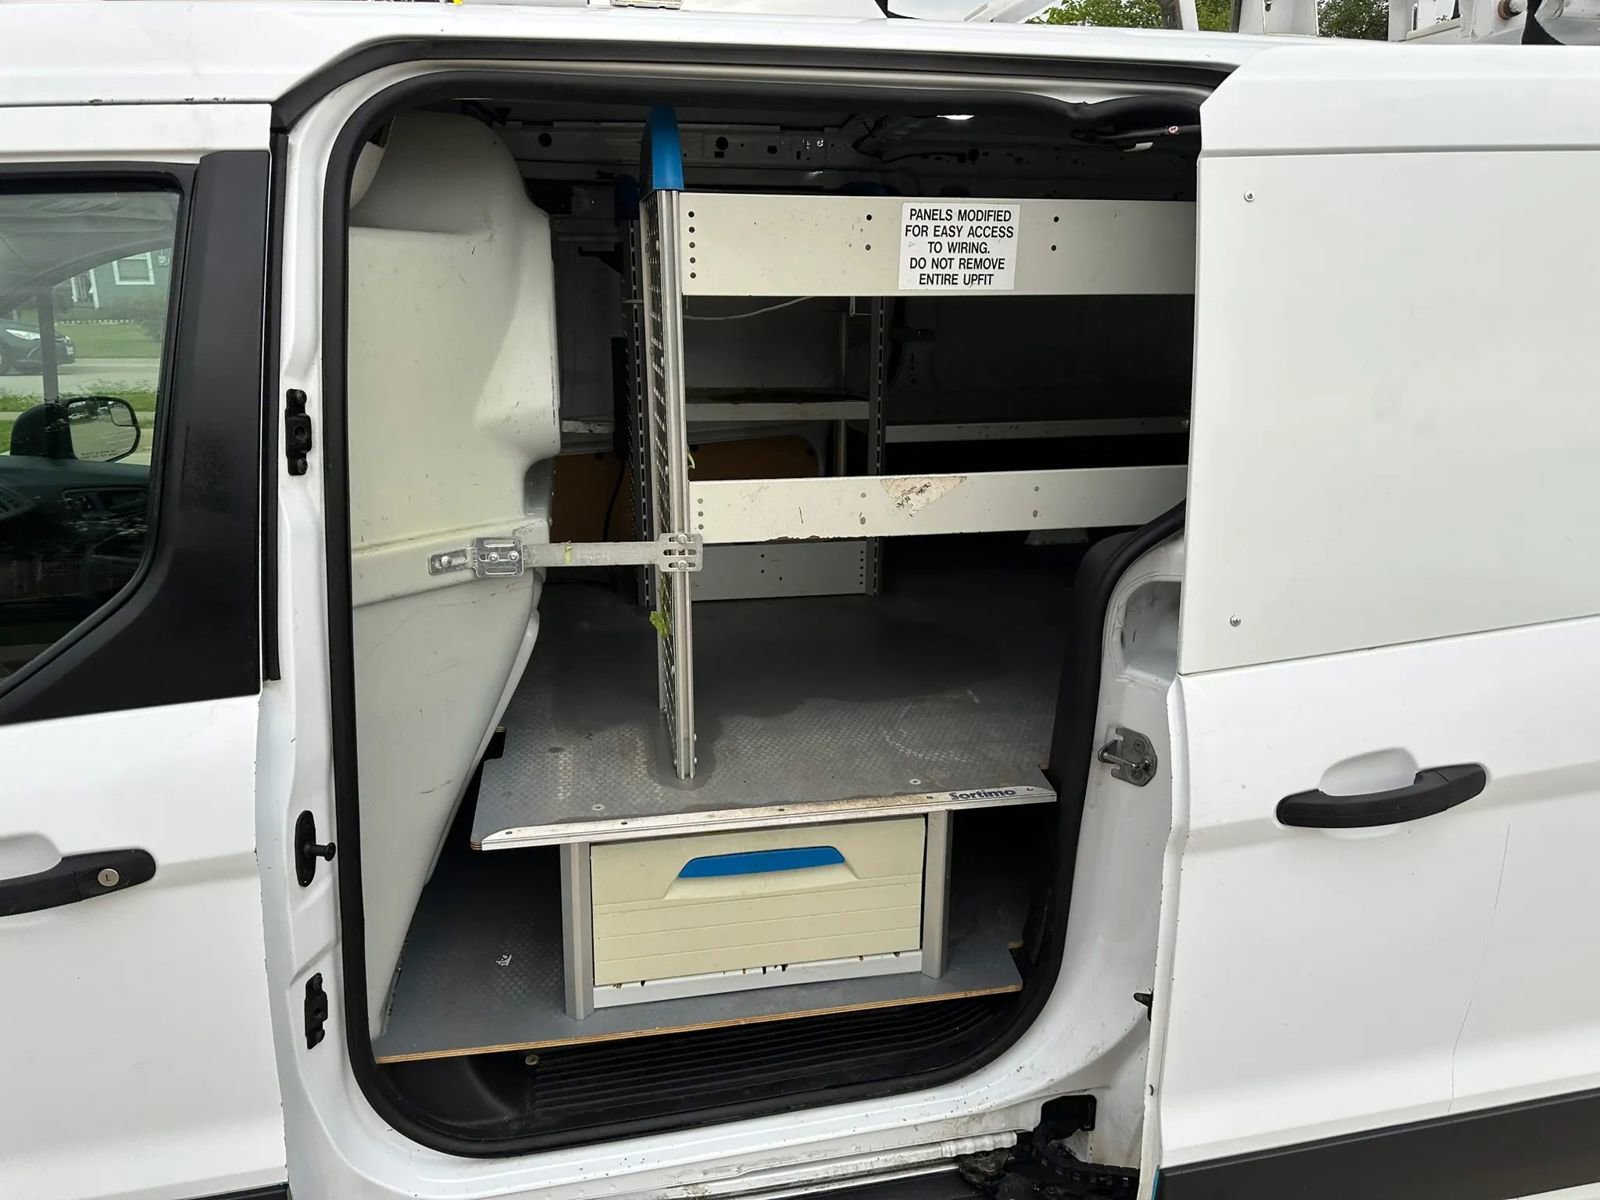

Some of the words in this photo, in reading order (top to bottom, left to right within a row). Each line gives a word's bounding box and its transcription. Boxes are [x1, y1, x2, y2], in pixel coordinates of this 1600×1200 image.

[909, 208, 953, 221] PANELS
[957, 209, 1012, 222] MODIFIED
[905, 225, 929, 237] FOR
[933, 225, 964, 238] EASY
[967, 226, 1014, 238] ACCESS
[928, 241, 943, 254] TO
[947, 241, 990, 254] WIRING.
[909, 257, 927, 269] DO
[931, 257, 955, 270] NOT
[958, 258, 1006, 270] REMOVE
[919, 273, 959, 285] ENTIRE
[963, 273, 994, 286] UPFIT
[948, 789, 1017, 801] Sortimo
